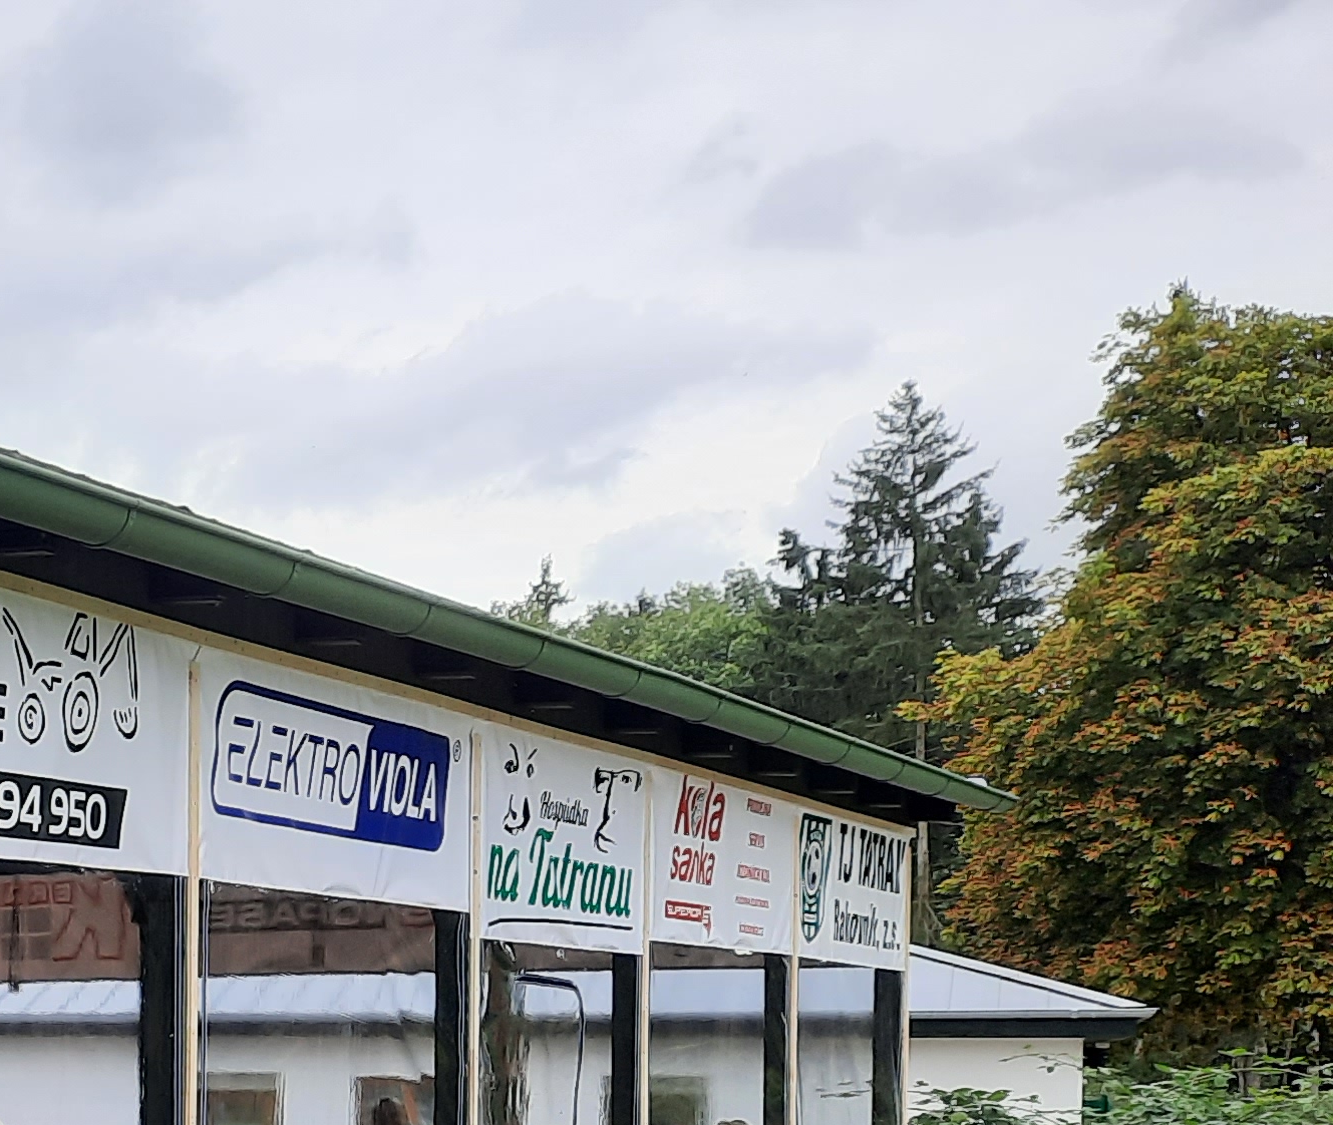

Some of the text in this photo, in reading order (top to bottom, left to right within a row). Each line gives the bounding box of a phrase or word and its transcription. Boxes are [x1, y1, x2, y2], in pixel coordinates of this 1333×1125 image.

[48, 788, 107, 840] 950
[487, 828, 633, 918] na Tatranu
[838, 823, 907, 894] TJ TATRAN
